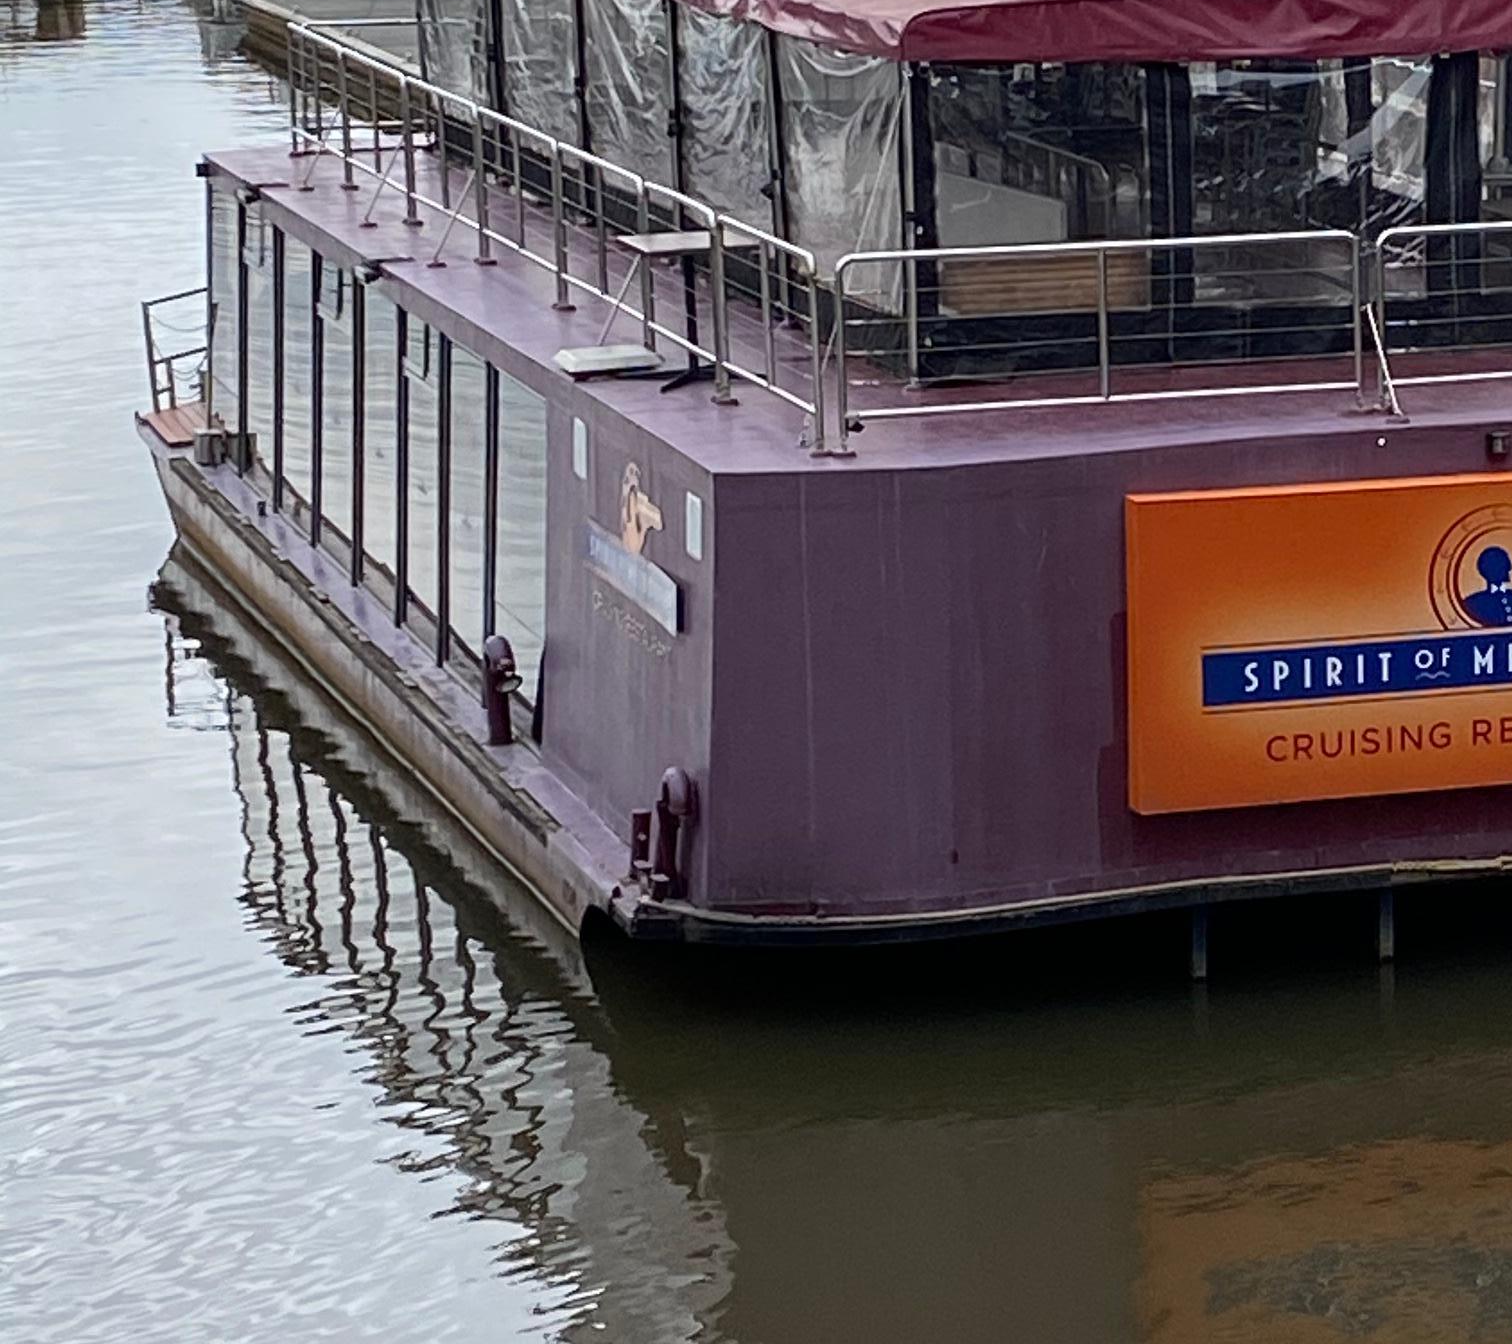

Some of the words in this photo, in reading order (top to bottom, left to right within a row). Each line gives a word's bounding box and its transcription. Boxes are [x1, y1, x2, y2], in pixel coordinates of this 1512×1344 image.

[1244, 651, 1393, 693] SPIRIT
[1414, 647, 1452, 670] OF
[1266, 721, 1452, 762] CRUISING
